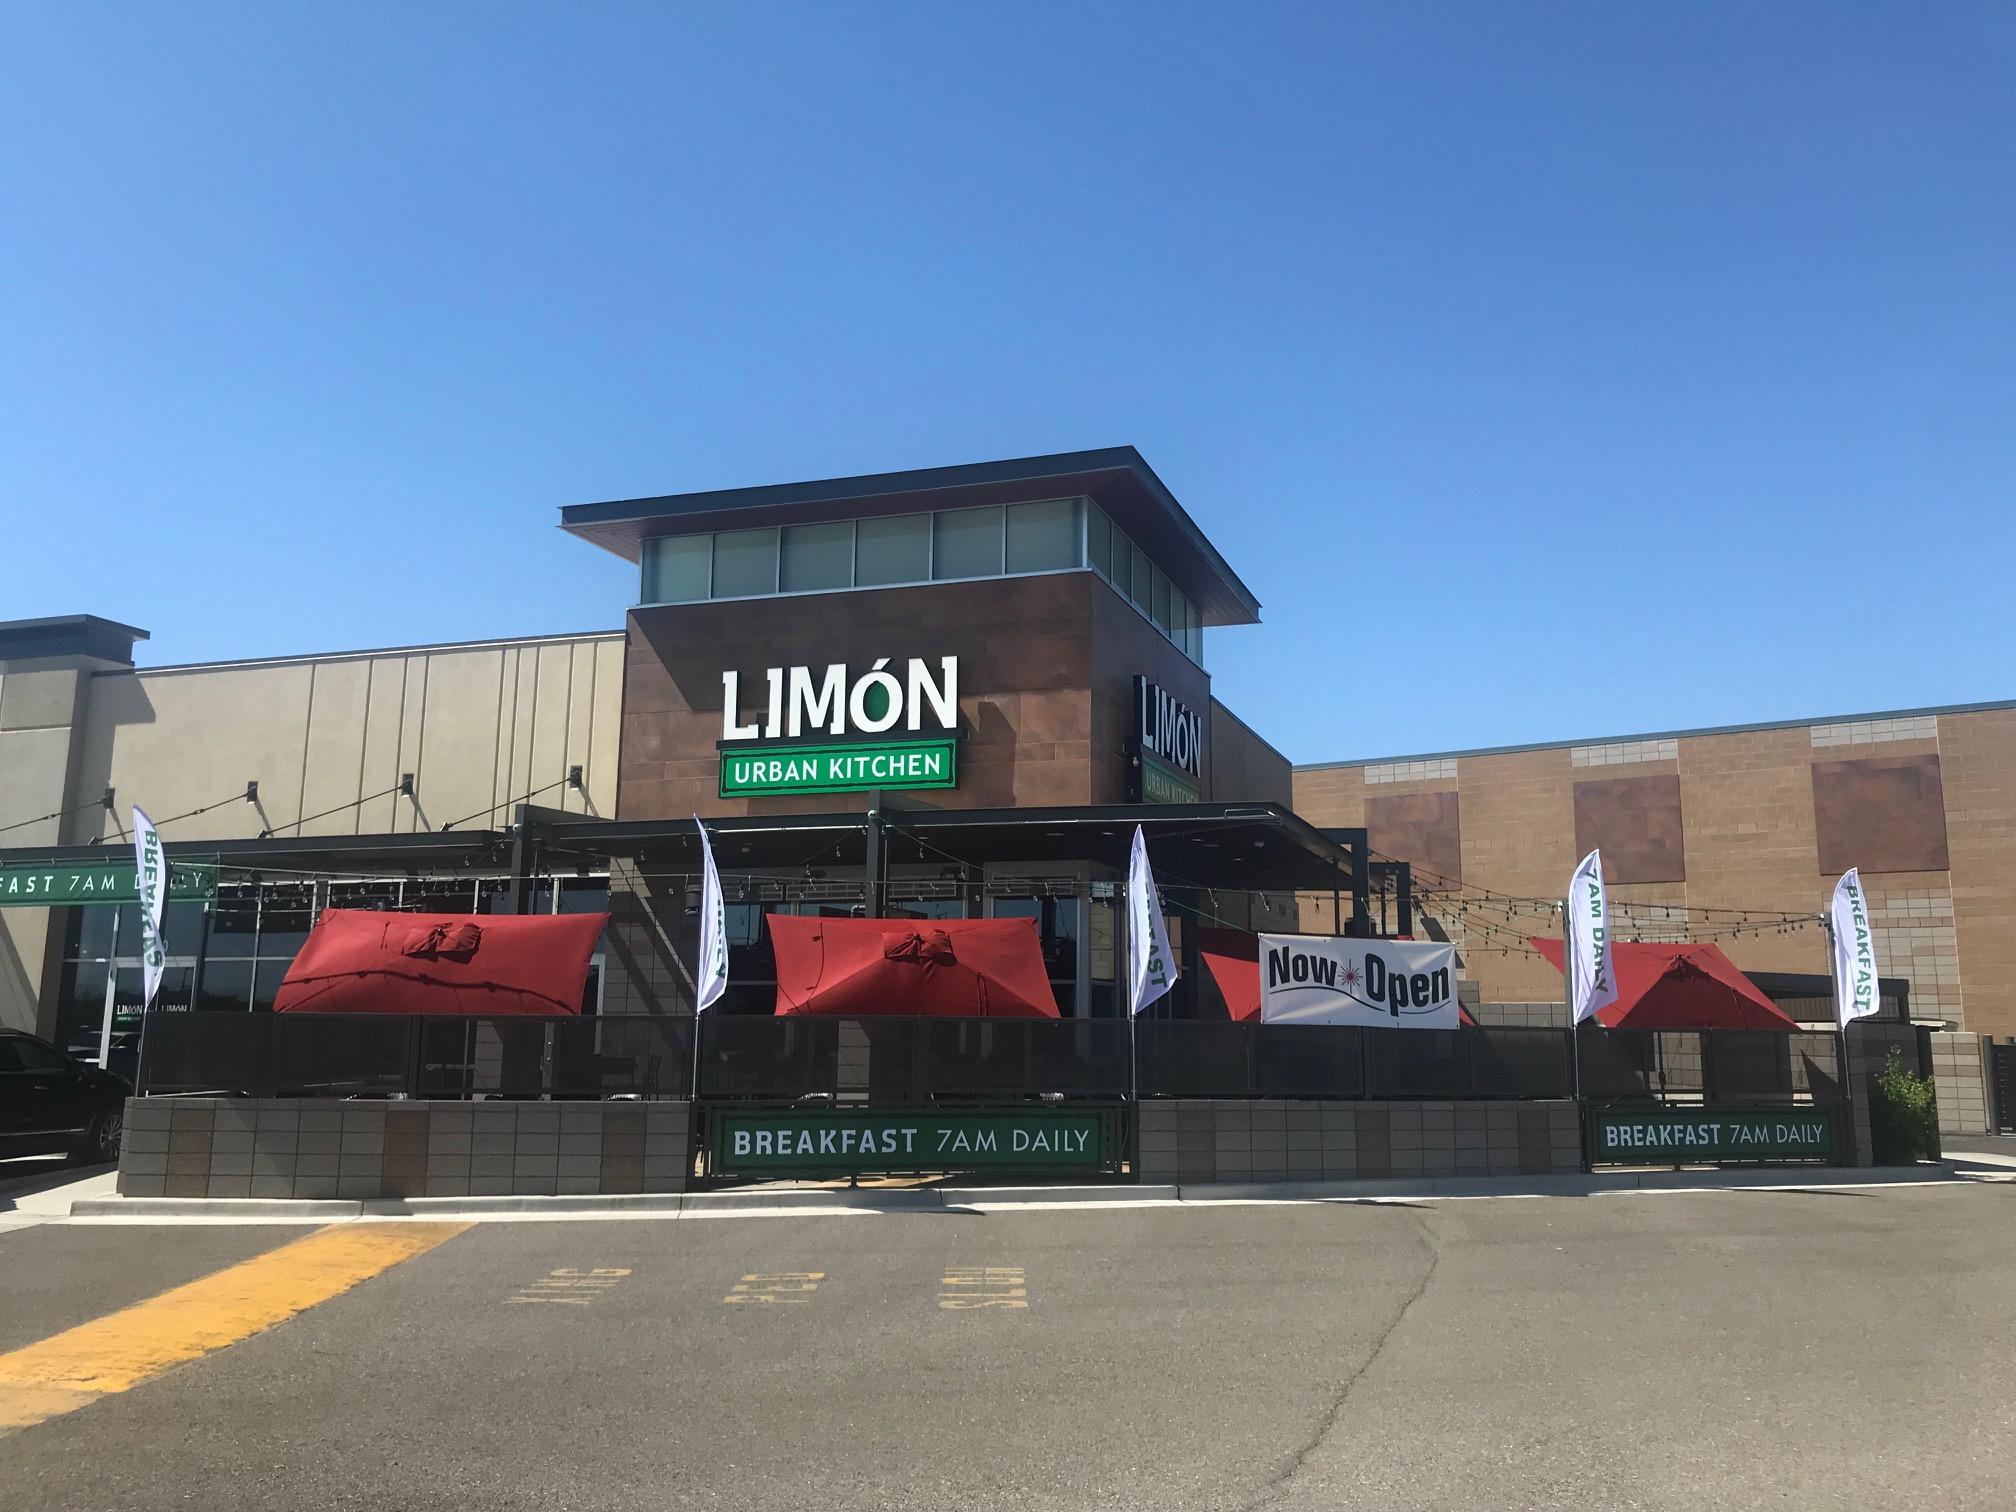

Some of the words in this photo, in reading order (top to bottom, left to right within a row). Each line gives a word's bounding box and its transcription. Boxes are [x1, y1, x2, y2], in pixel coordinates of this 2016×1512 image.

[722, 655, 958, 740] LIMÓN
[735, 759, 817, 783] URBAN
[829, 753, 941, 779] KITCHEN
[68, 875, 115, 892] 7AM
[1586, 868, 1602, 918] 7AM
[1592, 927, 1608, 993] DAILY
[1846, 885, 1873, 1011] BREAKFAST
[1268, 946, 1337, 988] Now
[1365, 953, 1450, 1018] Open
[734, 1128, 917, 1155] BREAKFAST
[937, 1129, 997, 1152] 7AM
[1012, 1129, 1090, 1152] DAILY
[1606, 1124, 1721, 1147] BREAKFAST
[1729, 1124, 1770, 1144] 7AM
[1776, 1123, 1823, 1143] DAILY
